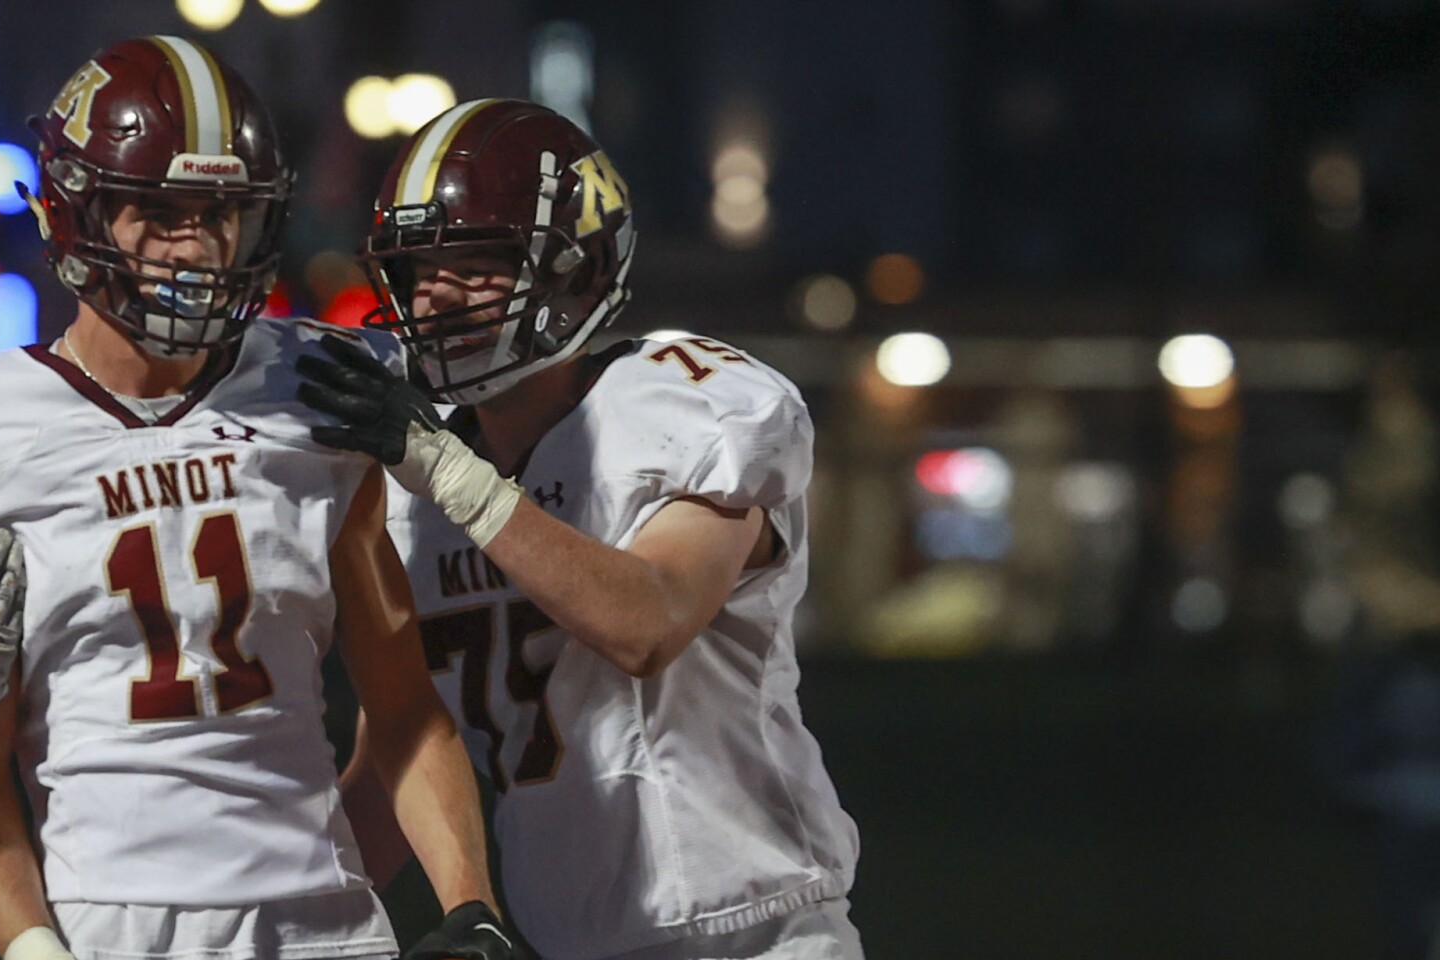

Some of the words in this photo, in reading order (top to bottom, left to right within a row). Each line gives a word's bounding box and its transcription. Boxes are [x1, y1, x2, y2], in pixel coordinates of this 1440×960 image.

[183, 160, 241, 175] Riddell
[97, 453, 238, 520] MINOT
[437, 546, 507, 598] MIN
[101, 509, 276, 725] 11
[415, 600, 565, 795] 75
